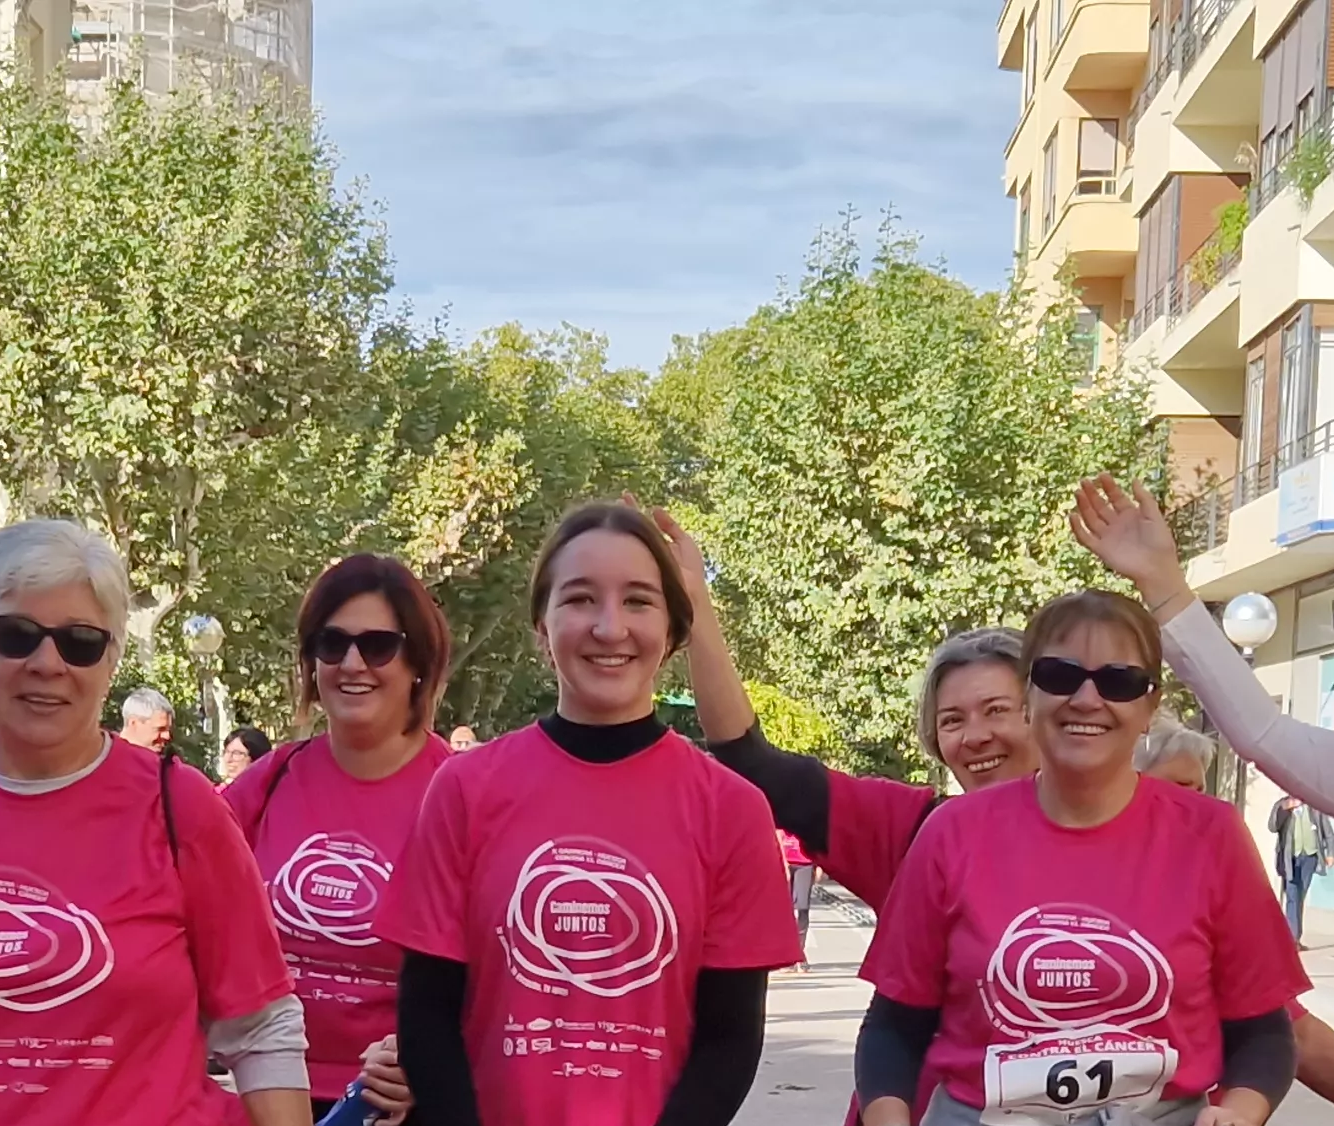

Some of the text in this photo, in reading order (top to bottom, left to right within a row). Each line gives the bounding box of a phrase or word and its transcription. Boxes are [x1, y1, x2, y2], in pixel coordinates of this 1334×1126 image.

[554, 916, 606, 932] JUNTOS
[1036, 971, 1091, 987] JUNTOS
[1008, 1038, 1156, 1060] CONTRA EL CÁNCER
[1058, 1036, 1103, 1047] HUESCA
[1046, 1060, 1113, 1105] 61
